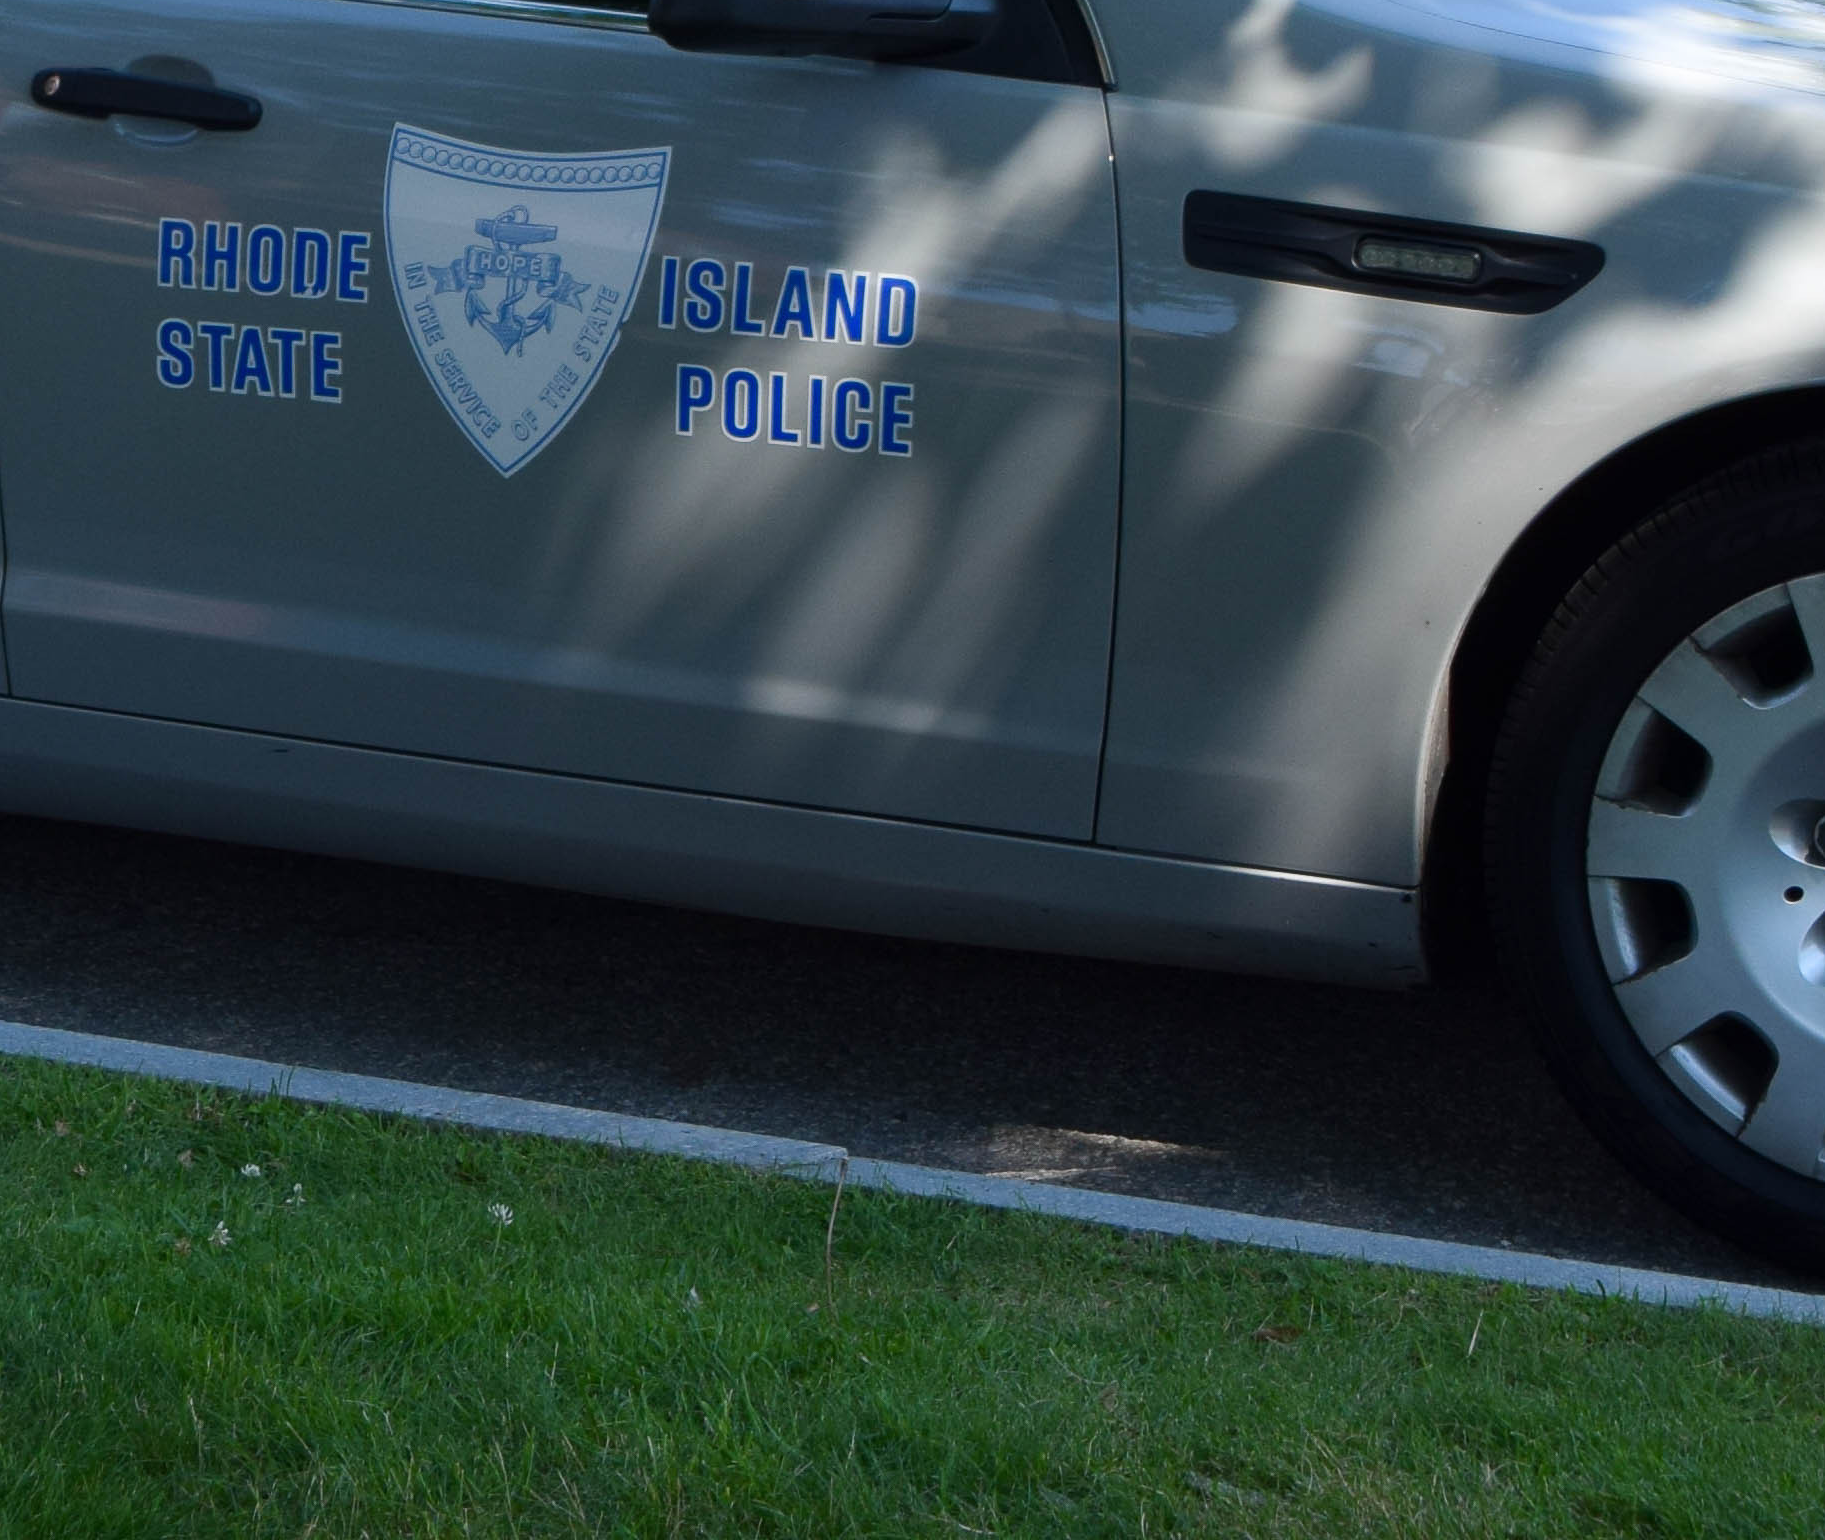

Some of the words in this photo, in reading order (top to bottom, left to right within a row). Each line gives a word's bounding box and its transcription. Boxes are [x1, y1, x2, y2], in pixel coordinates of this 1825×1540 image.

[157, 217, 371, 304] RHODE
[404, 261, 427, 291] IN
[478, 253, 544, 277] HOPE
[413, 294, 446, 347] THE
[574, 283, 621, 363] STATE
[659, 257, 918, 349] ISLAND
[156, 317, 343, 404] STATE
[434, 347, 502, 440] SERVICE
[538, 363, 579, 410] THE
[513, 408, 539, 442] OF
[676, 364, 915, 458] POLICE
